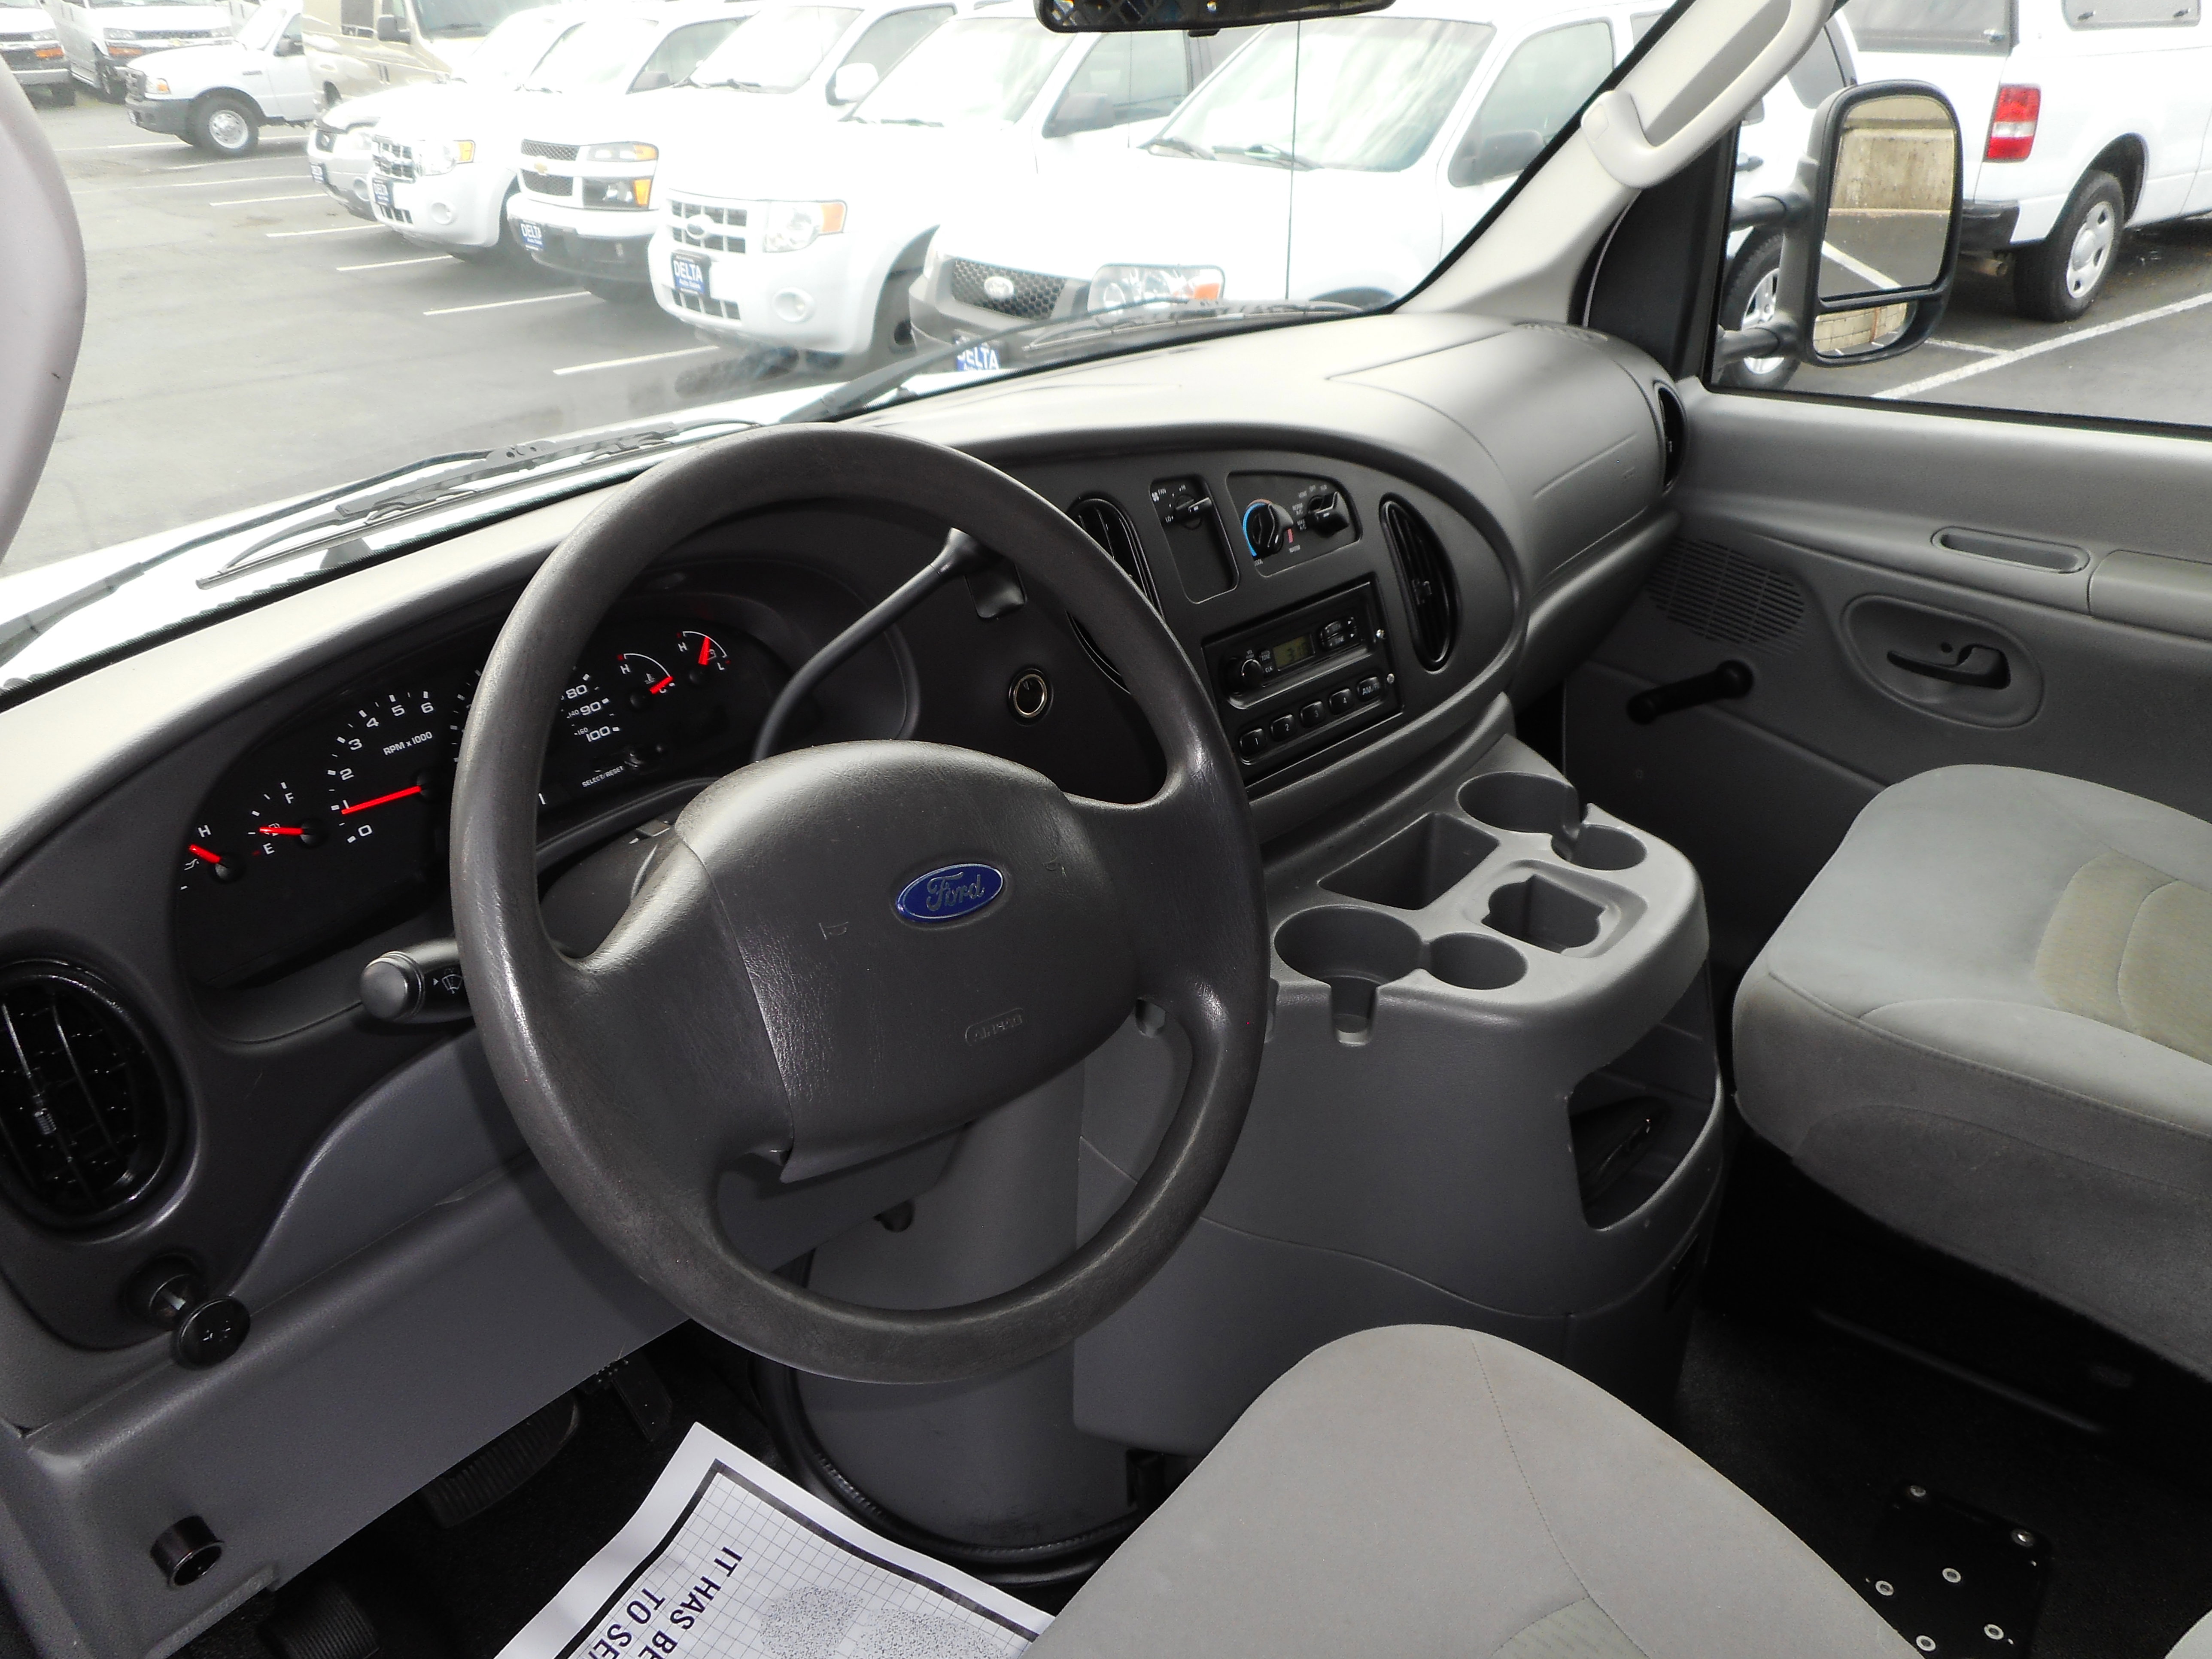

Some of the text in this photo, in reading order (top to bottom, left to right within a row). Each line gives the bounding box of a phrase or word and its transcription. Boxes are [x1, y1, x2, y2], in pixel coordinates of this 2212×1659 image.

[520, 223, 542, 238] DELTA
[673, 260, 703, 282] DELTA
[678, 642, 688, 652] H
[620, 664, 631, 674] H
[565, 684, 587, 699] 80
[391, 705, 405, 716] 5
[421, 702, 434, 713] 6
[580, 702, 601, 716] 90
[366, 717, 379, 728] 4
[586, 726, 610, 742] 100
[348, 738, 362, 750] 3
[383, 741, 405, 755] RPM
[411, 731, 433, 744] 1000
[340, 768, 354, 780] 2
[582, 766, 624, 787] SELECT/RESET
[285, 792, 294, 804] F
[198, 825, 211, 837] H
[358, 825, 372, 836] 0
[263, 843, 275, 854] E
[926, 872, 985, 912] Ford
[714, 1547, 743, 1577] IT
[669, 1576, 721, 1630] HAS
[587, 1588, 665, 1659] TO SE
